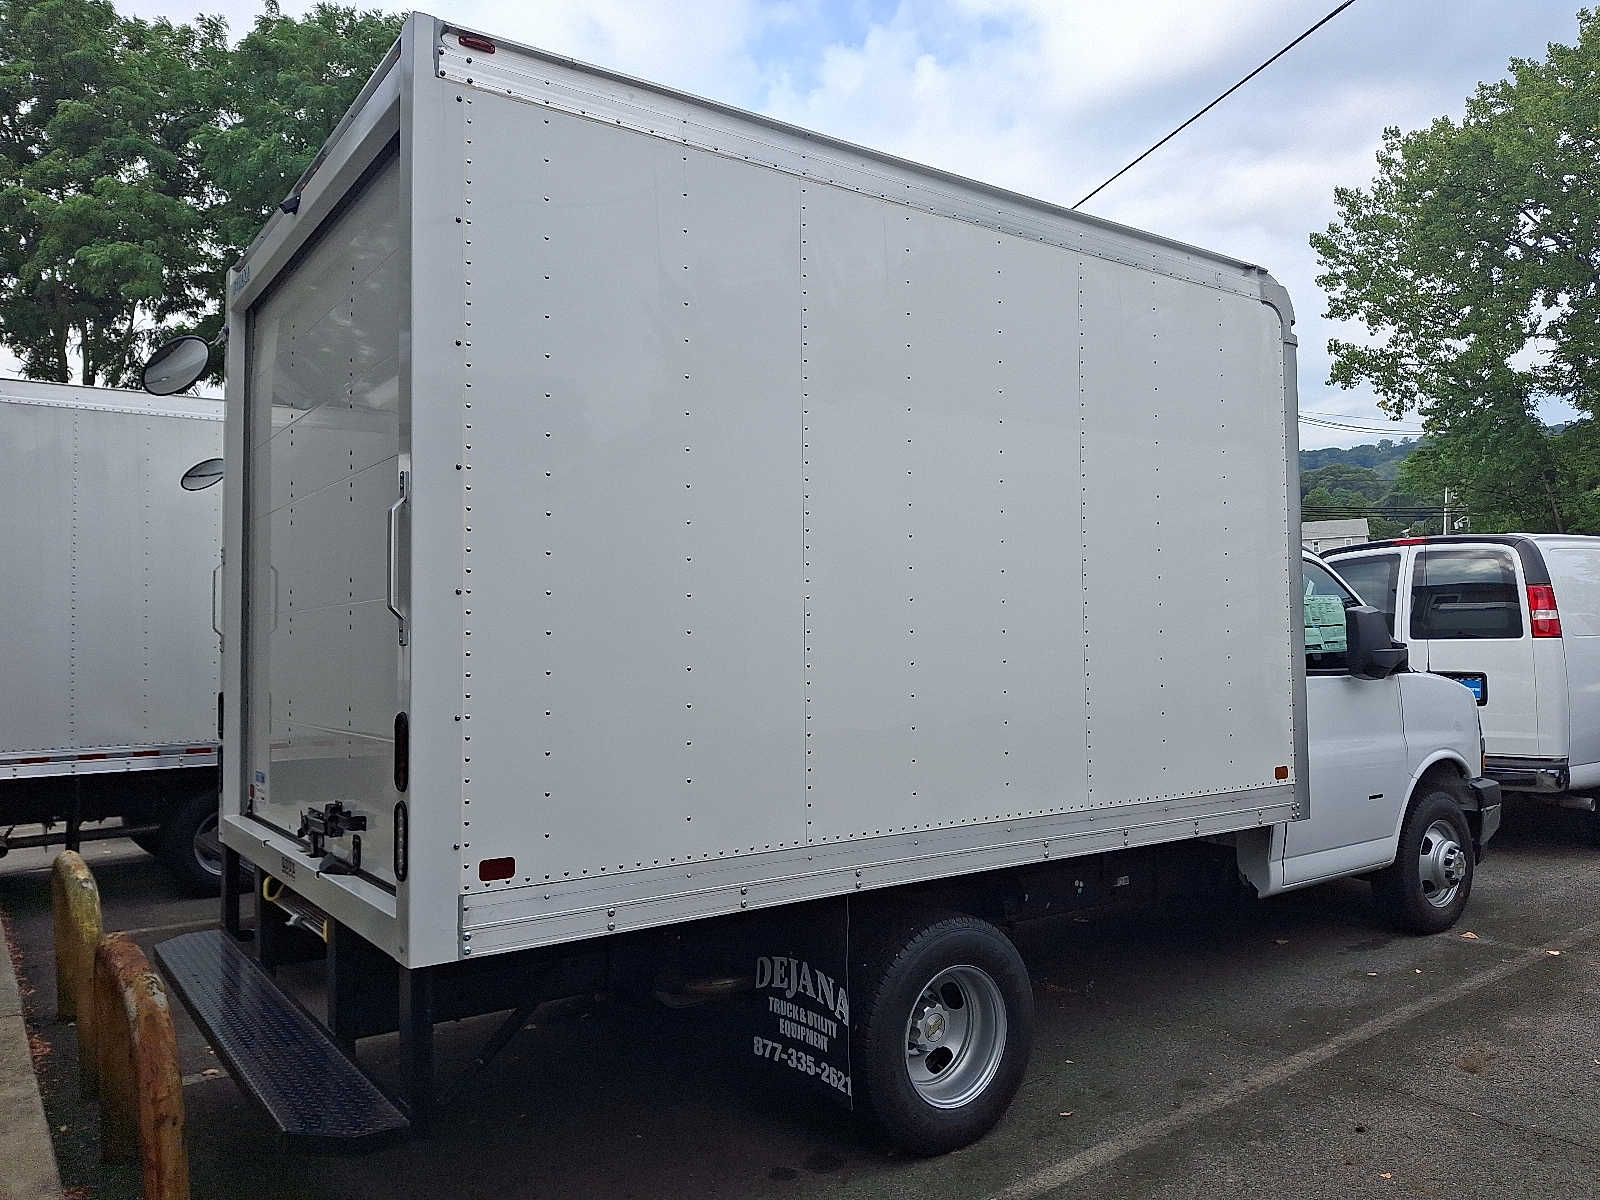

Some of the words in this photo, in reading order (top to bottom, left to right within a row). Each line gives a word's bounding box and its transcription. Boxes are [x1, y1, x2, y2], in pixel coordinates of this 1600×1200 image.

[755, 956, 849, 1026] DEJANA
[768, 996, 800, 1021] TRUCK
[800, 1007, 807, 1023] &
[807, 1009, 838, 1038] UTILITY
[779, 1018, 829, 1053] EQUIPMENT
[753, 1036, 852, 1096] 877-335-2621
